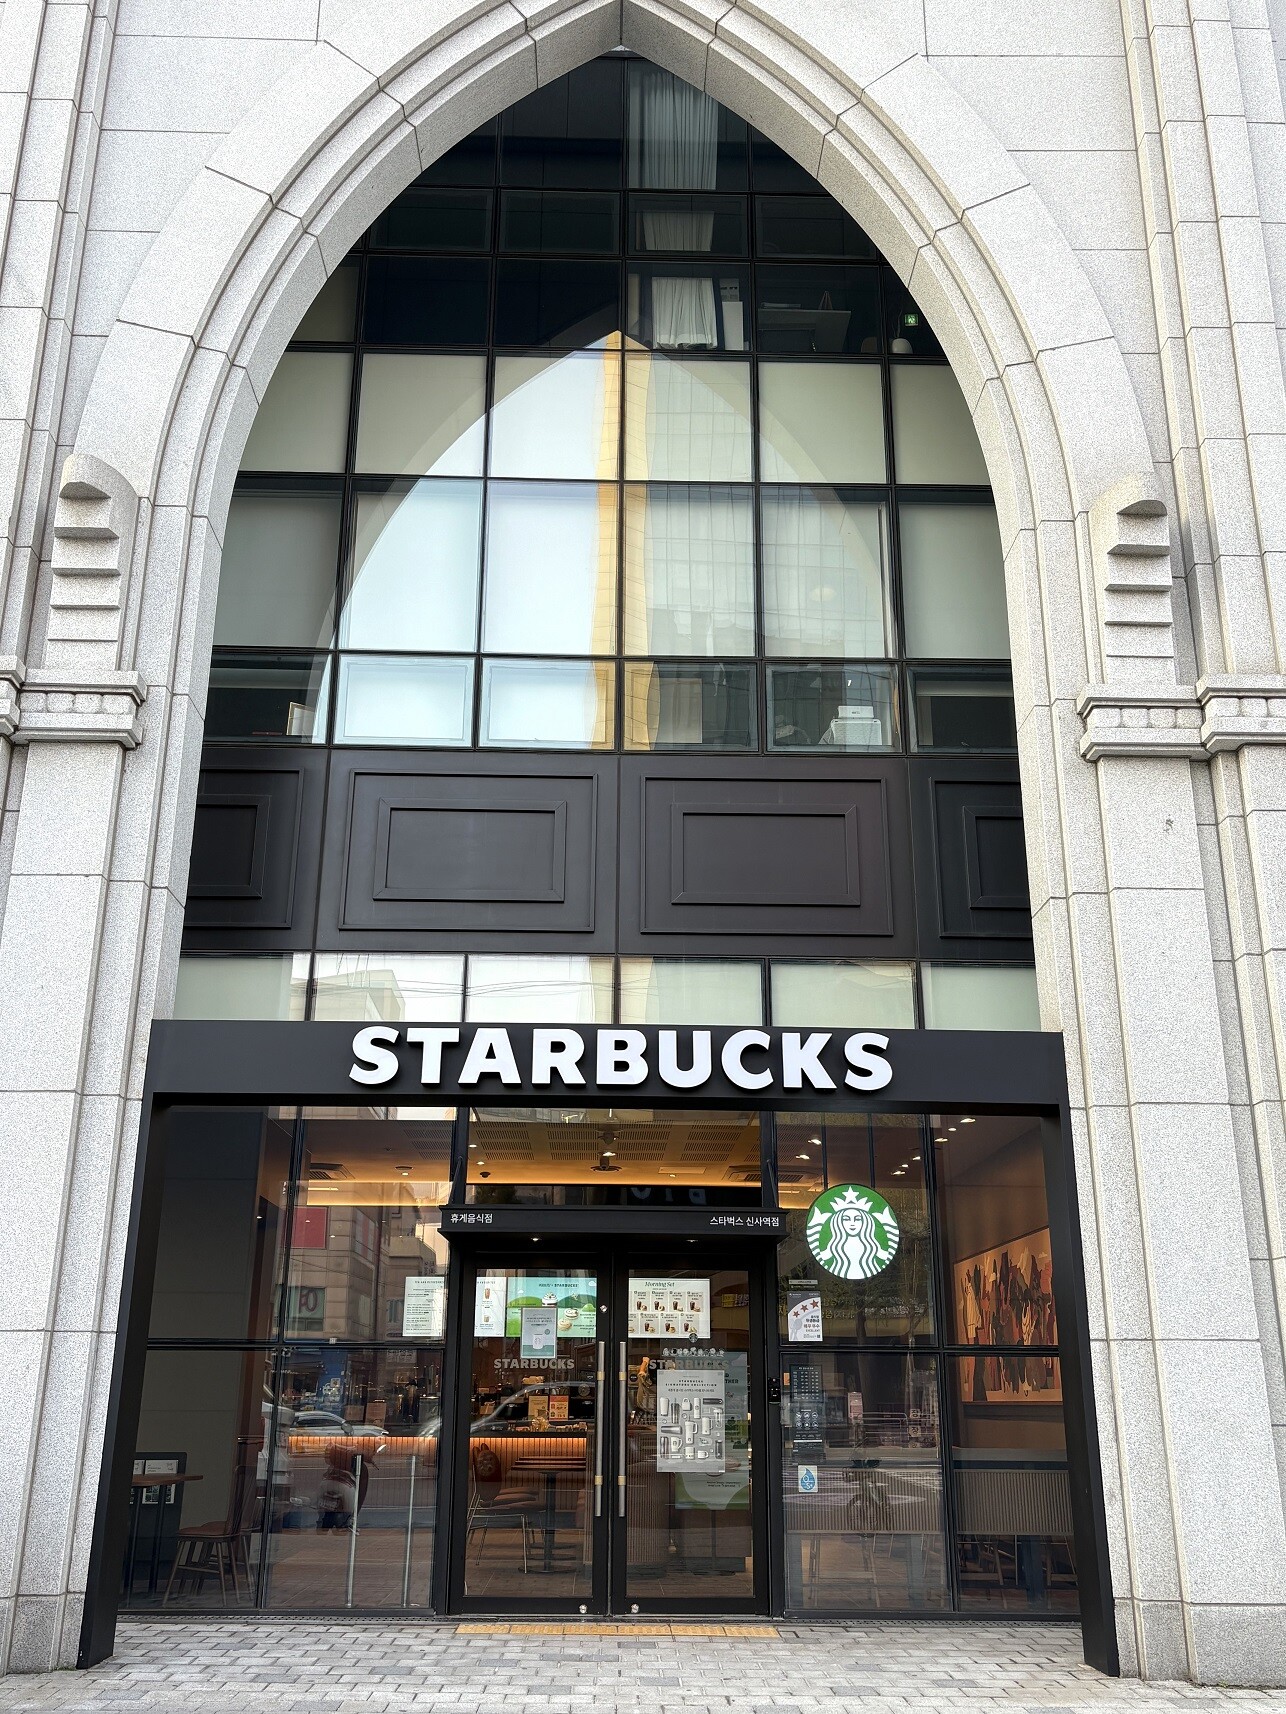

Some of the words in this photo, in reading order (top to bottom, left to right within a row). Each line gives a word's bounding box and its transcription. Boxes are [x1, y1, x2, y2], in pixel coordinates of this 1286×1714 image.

[348, 1025, 894, 1092] STARBUCKS
[450, 1213, 493, 1224] 휴게음식점
[709, 1215, 744, 1226] 스타벅스
[745, 1215, 780, 1227] 신사역점
[493, 1358, 575, 1370] STARBUCKS
